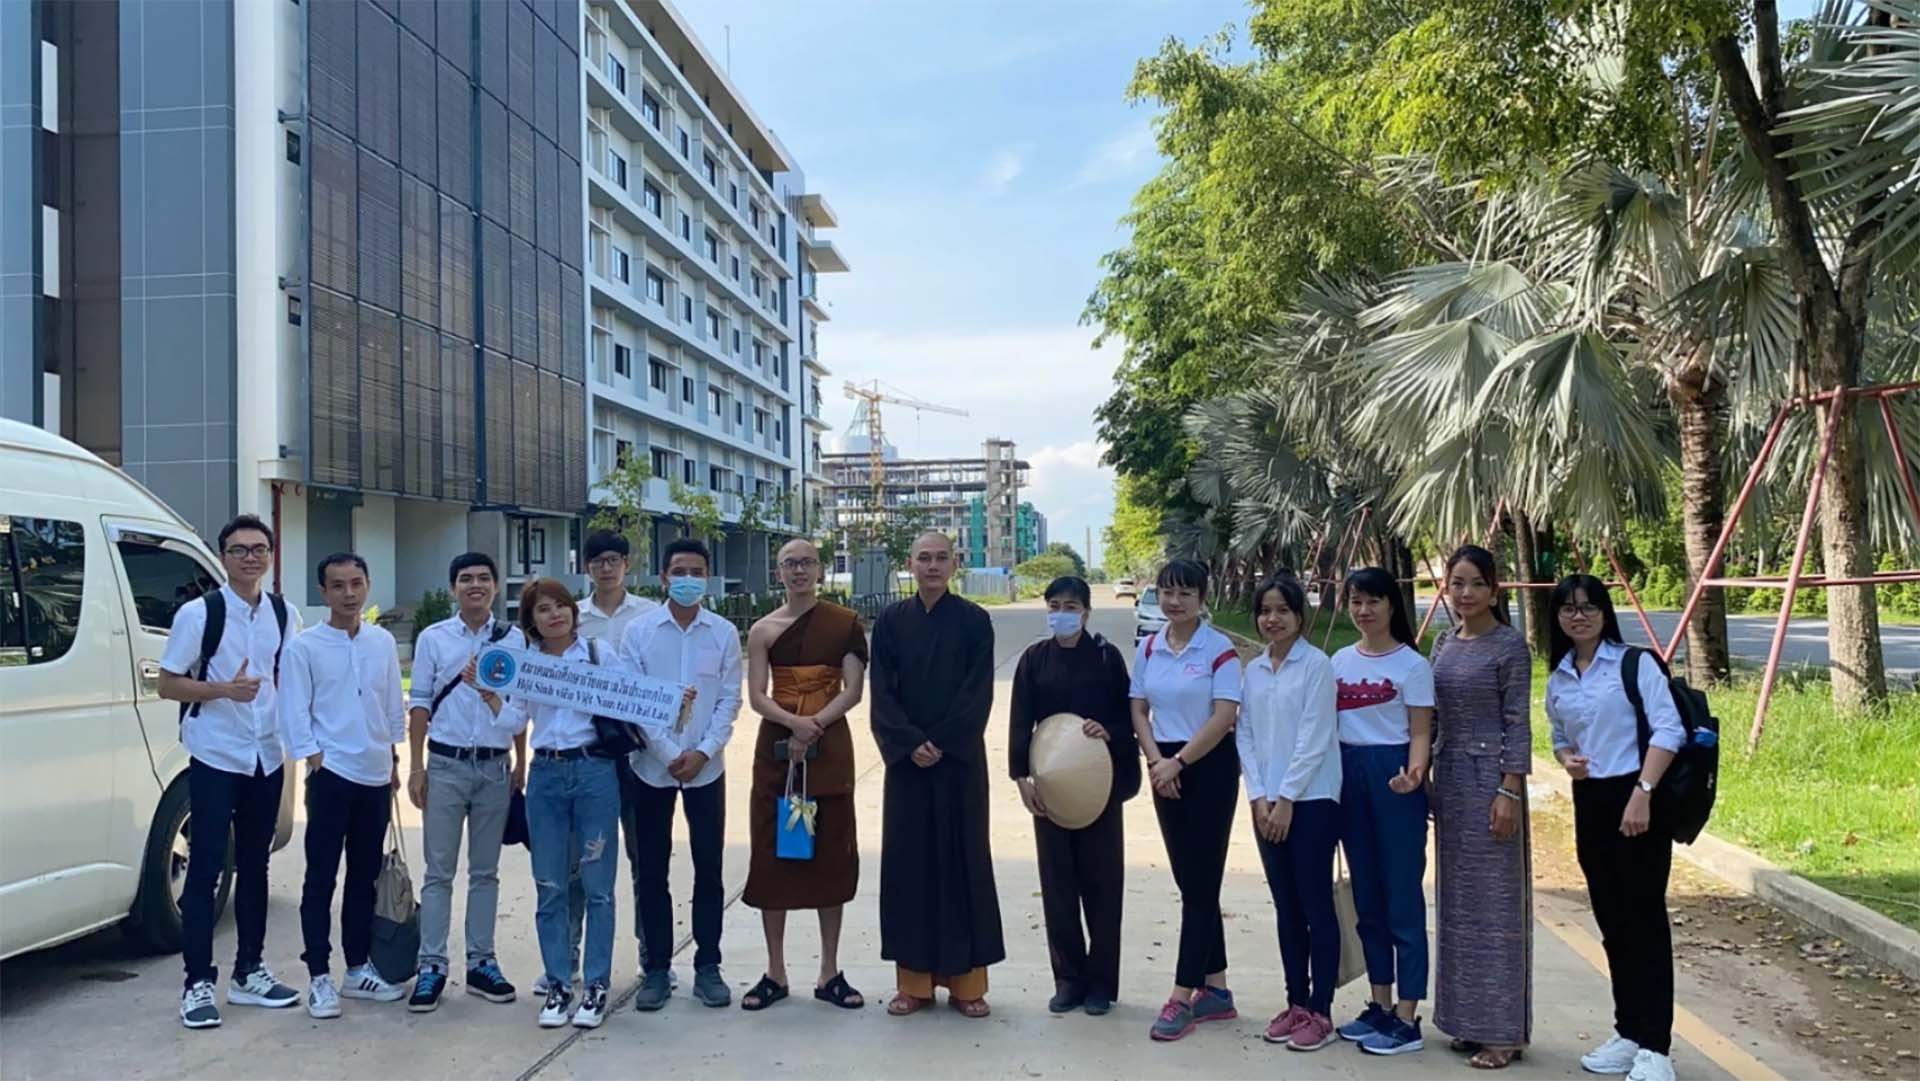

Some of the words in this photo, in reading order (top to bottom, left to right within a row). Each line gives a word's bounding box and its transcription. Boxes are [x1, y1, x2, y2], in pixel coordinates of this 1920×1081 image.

[535, 682, 554, 696] Sinh
[596, 695, 615, 709] Nam
[651, 707, 669, 721] Lan
